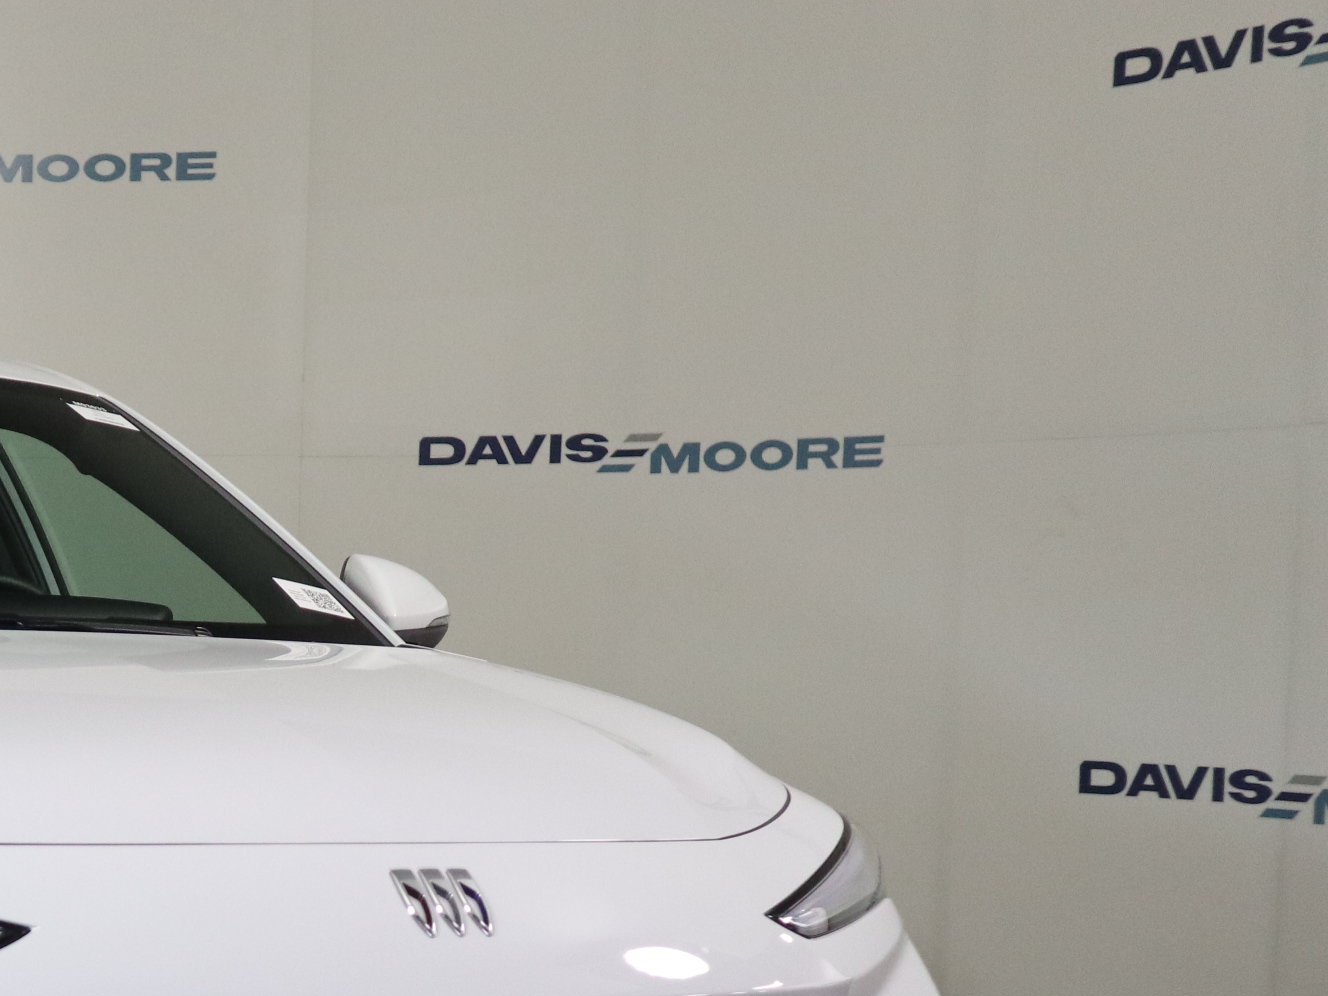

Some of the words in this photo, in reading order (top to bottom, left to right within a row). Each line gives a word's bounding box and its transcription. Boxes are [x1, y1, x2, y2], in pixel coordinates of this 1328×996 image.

[1112, 17, 1315, 89] DAVIS
[417, 432, 610, 467] DAVIS
[649, 434, 886, 475] MOORE
[1077, 759, 1274, 806] DAVIS
